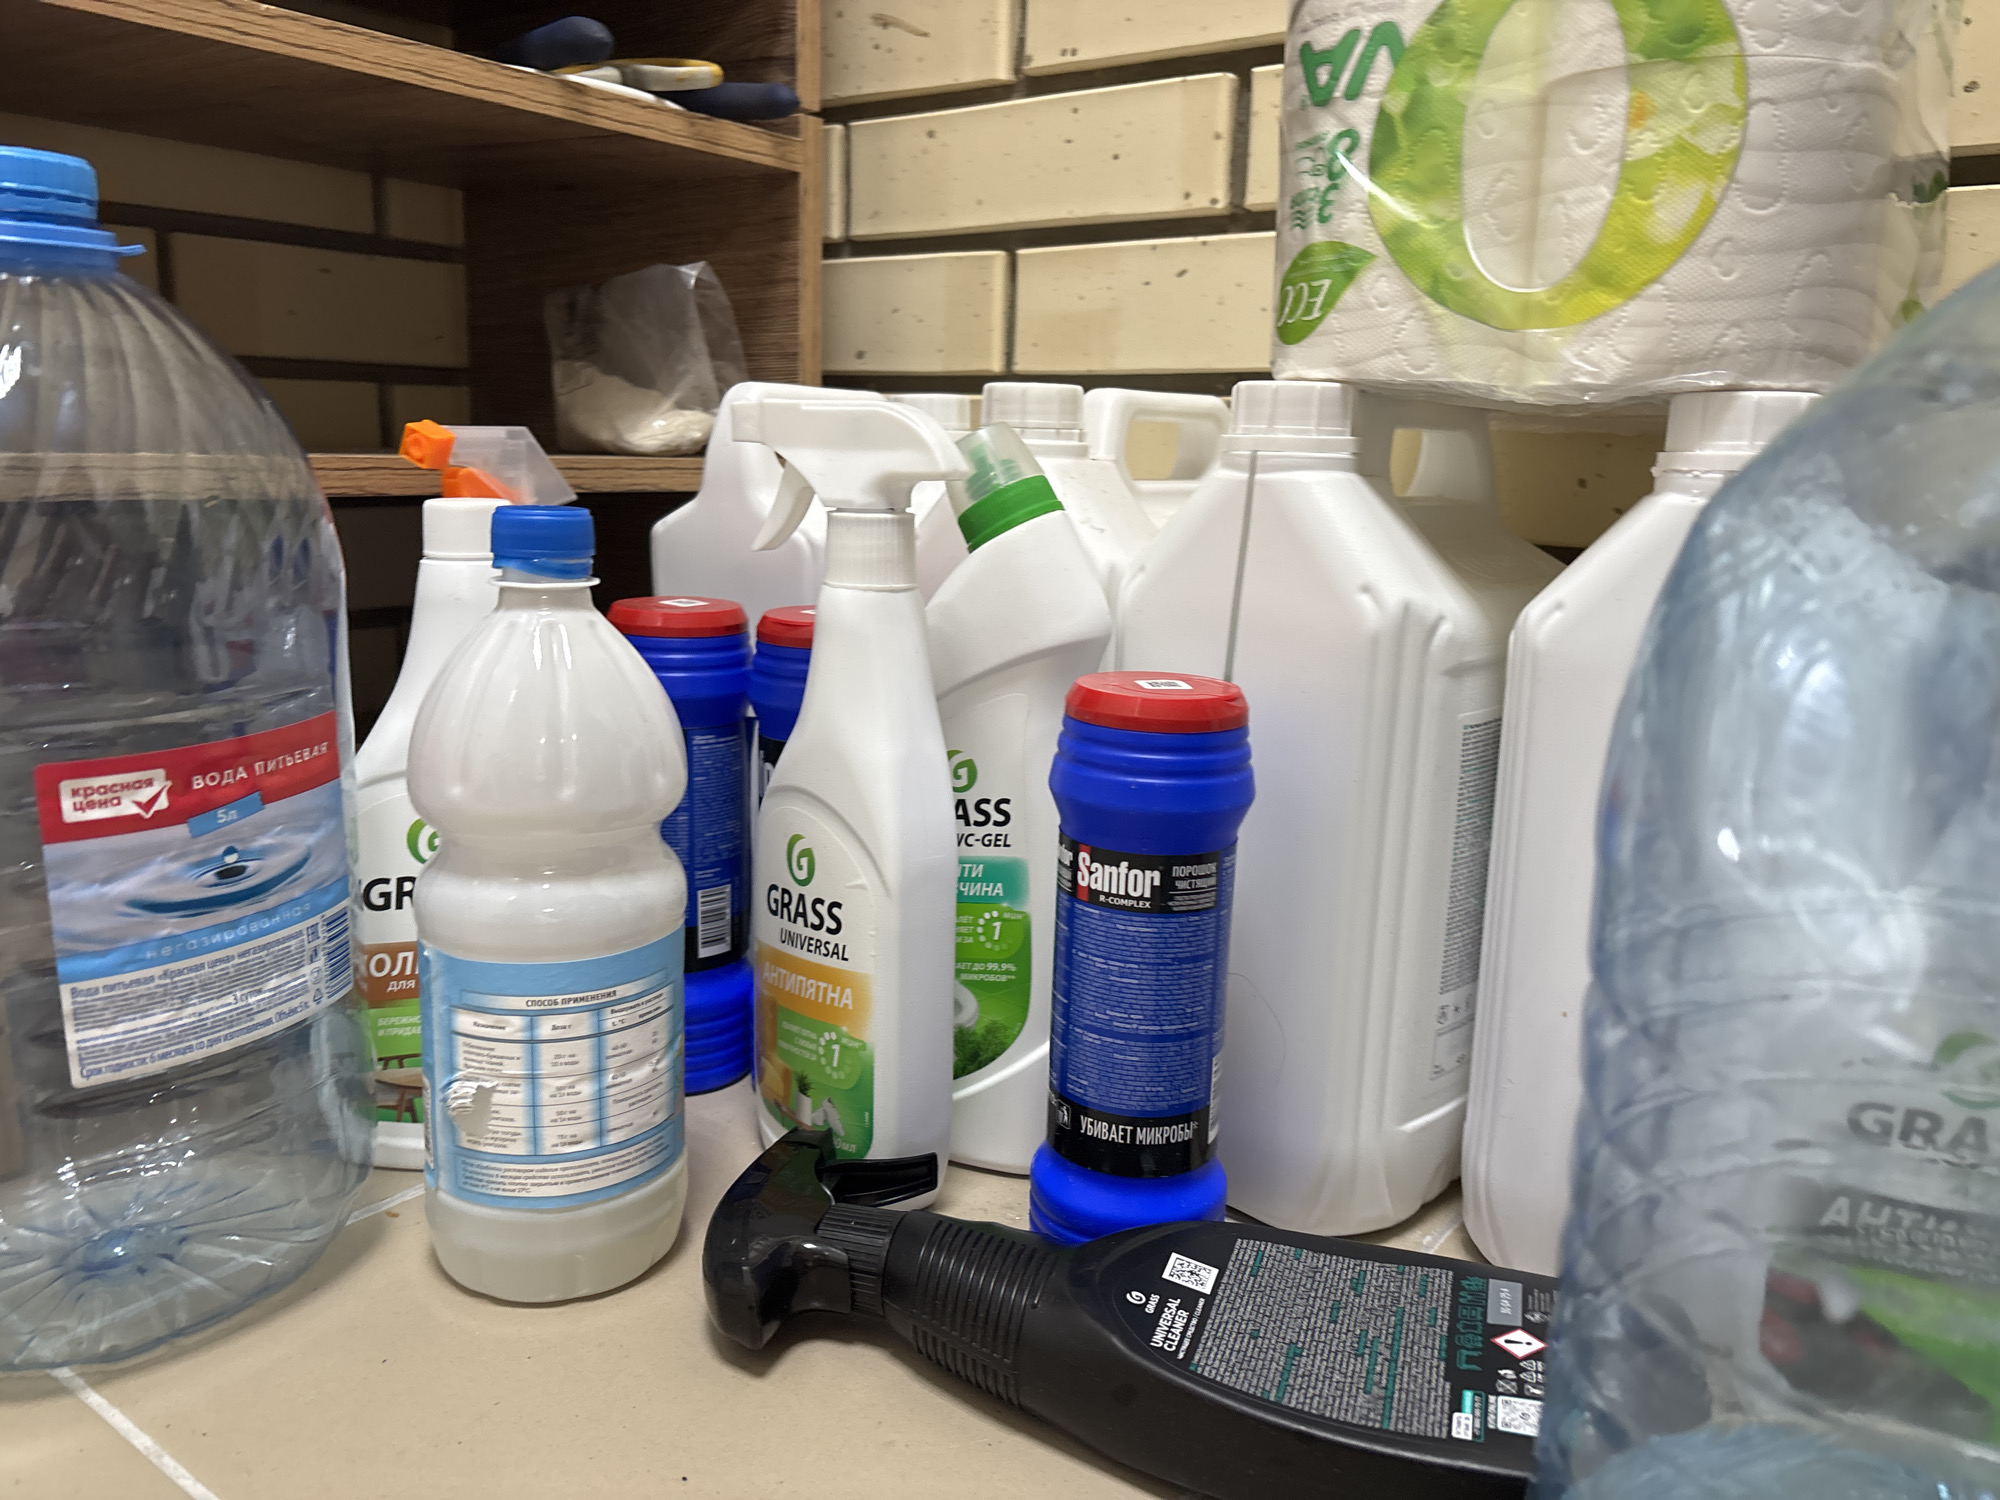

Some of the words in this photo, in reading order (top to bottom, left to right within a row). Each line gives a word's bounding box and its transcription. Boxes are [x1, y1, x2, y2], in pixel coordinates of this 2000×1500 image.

[192, 766, 248, 790] ВОДА
[254, 741, 329, 775] ПИТЬЕВАЯ
[71, 777, 155, 799] красная
[73, 796, 122, 813] цена
[216, 808, 238, 824] 5л
[957, 863, 985, 878] ТИ
[1077, 851, 1161, 898] Sanfor
[1172, 861, 1218, 878] ПОРОШОК
[956, 882, 1005, 897] ЧИНА
[1174, 874, 1217, 889] ЧИСТЯЩИЙ
[767, 883, 843, 936] GRASS
[1099, 894, 1152, 909] R-COMPLEX
[145, 902, 312, 960] негазированная
[780, 927, 850, 962] UNIVERSAL
[366, 950, 419, 978] ОЛ
[986, 962, 1017, 973] 99,9%
[762, 961, 854, 1010] АНТИПЯТНА
[525, 998, 559, 1008] СПОСОБ
[560, 989, 617, 1006] ПРИМЕНЕНИЯ
[831, 1043, 841, 1068] 1
[1080, 1115, 1134, 1144] УБИВАЕТ
[1144, 1293, 1160, 1314] GRASS
[1150, 1297, 1181, 1348] UNIVERSAL
[1163, 1309, 1190, 1352] CLEANER
